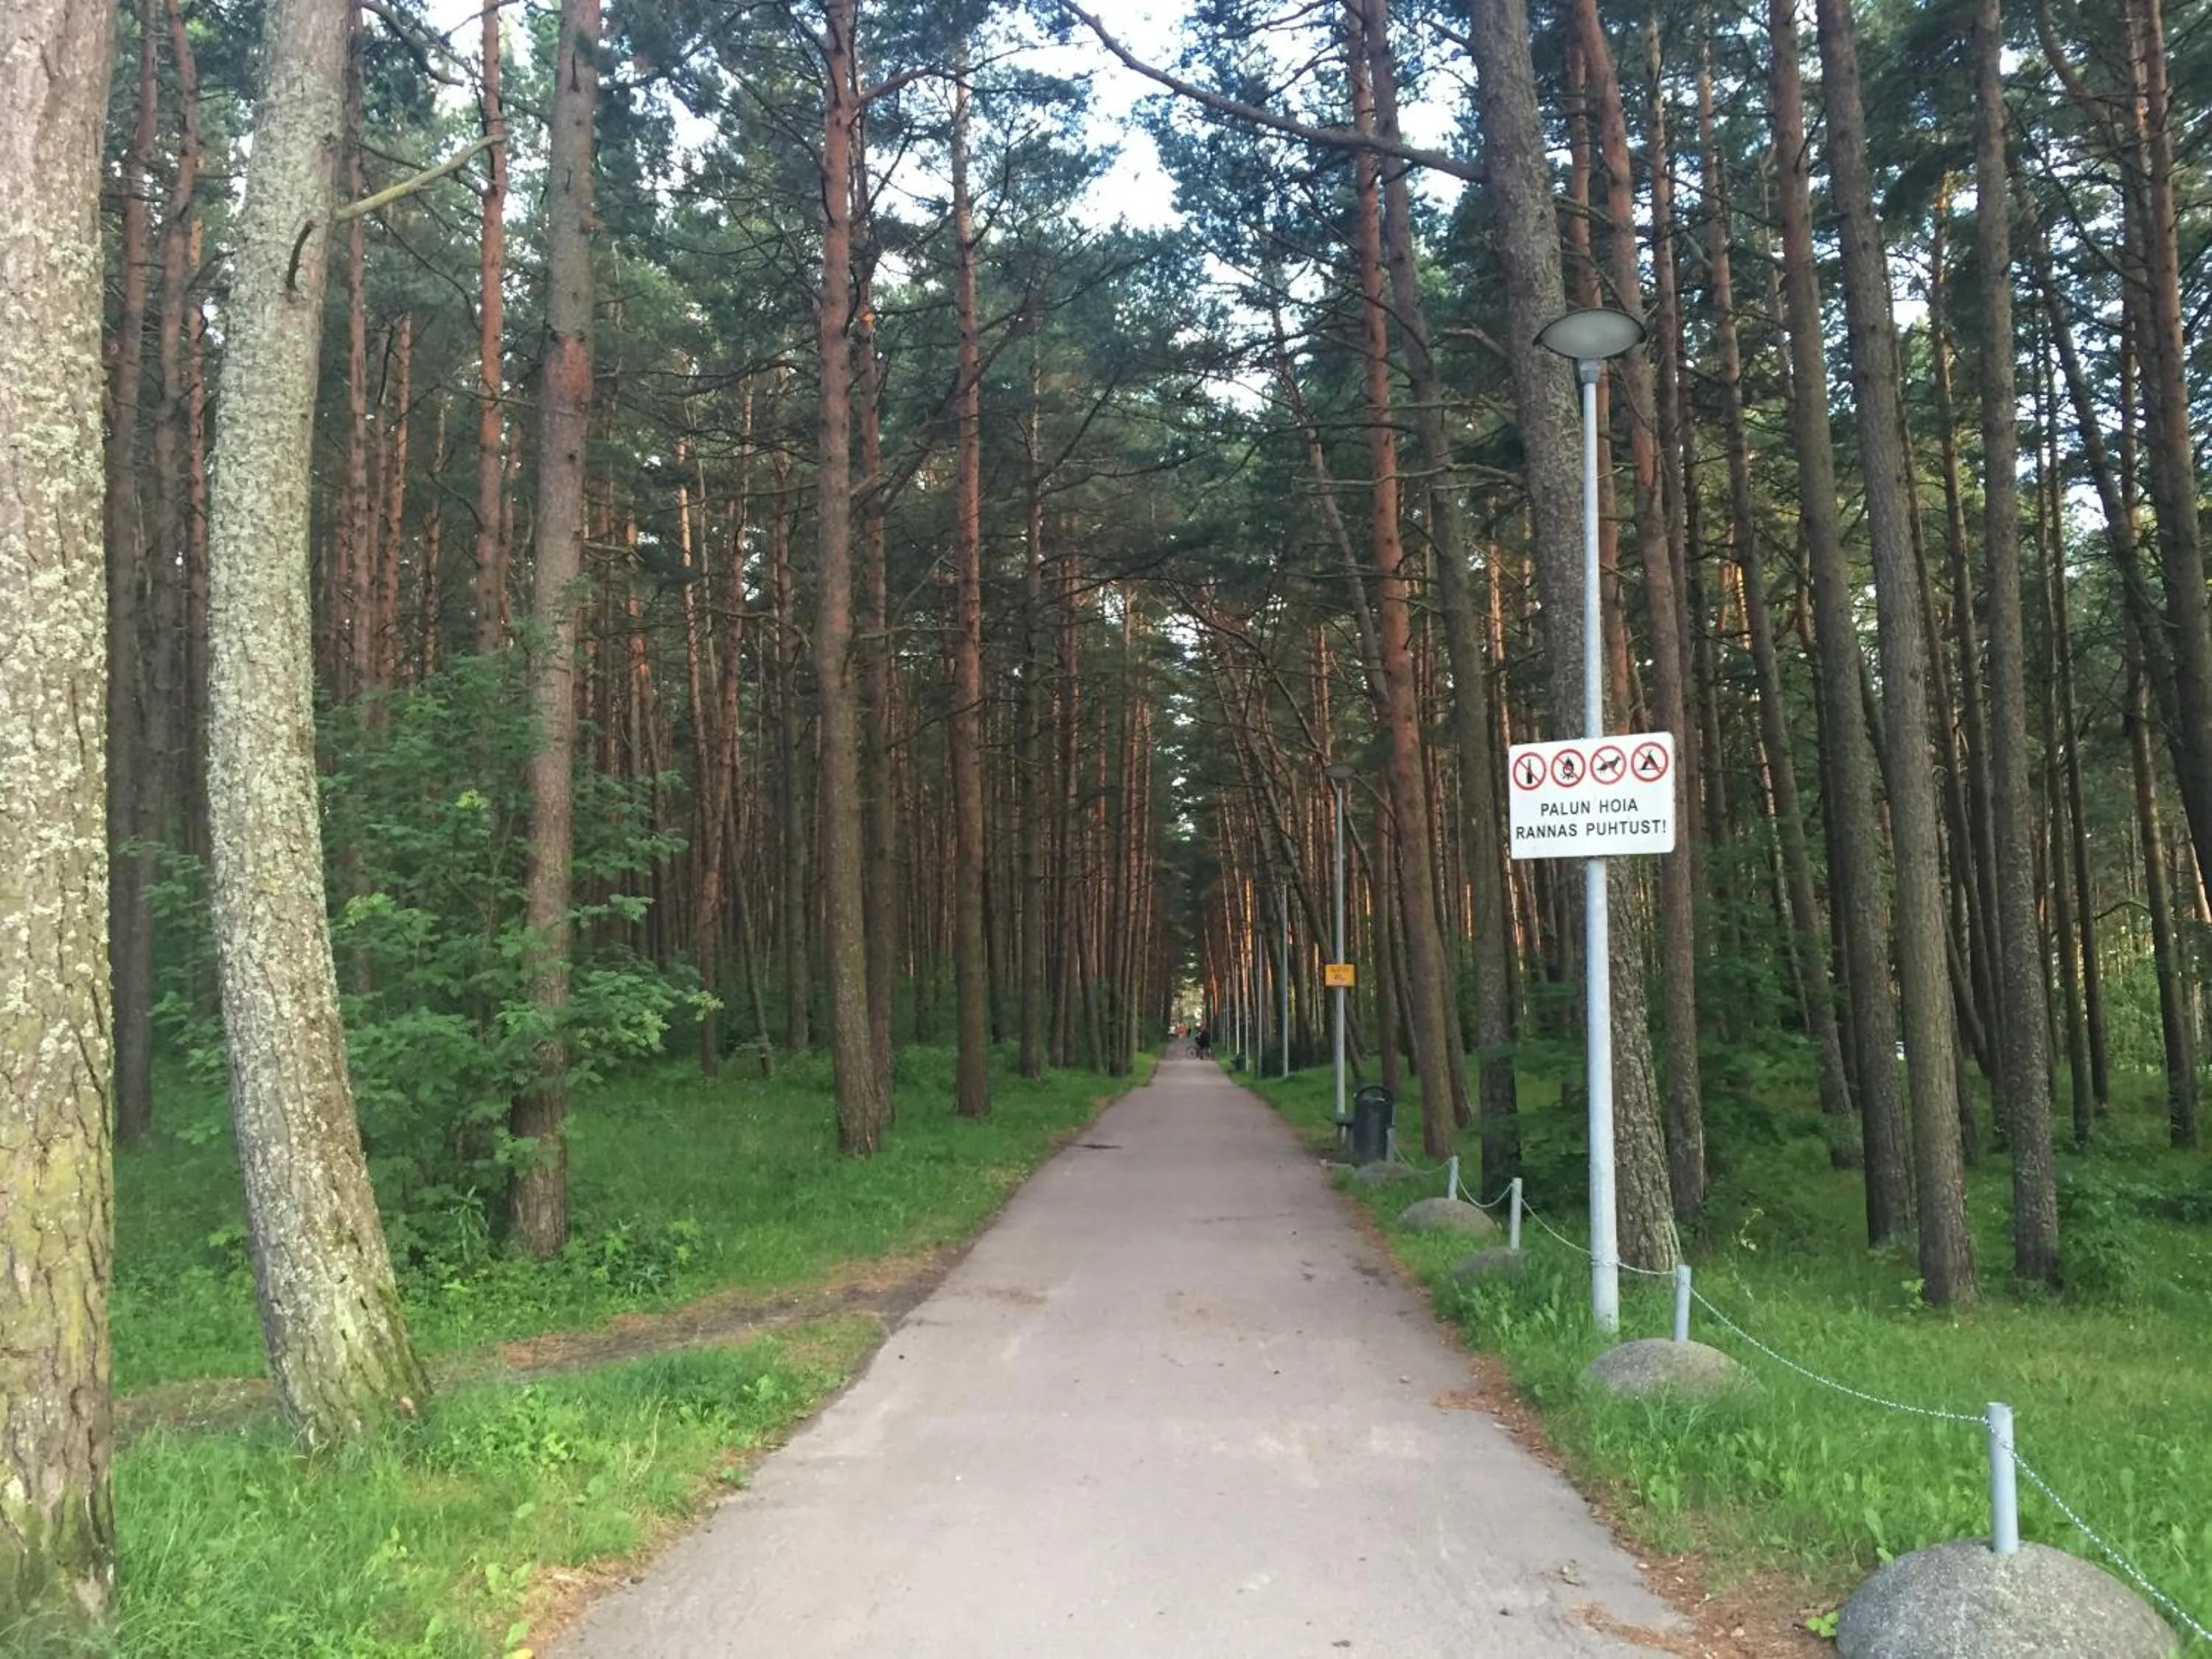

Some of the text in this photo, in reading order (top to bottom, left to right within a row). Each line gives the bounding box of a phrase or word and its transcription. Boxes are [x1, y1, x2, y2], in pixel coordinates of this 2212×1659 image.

[1540, 798, 1638, 816] PALUN HOIA
[1516, 819, 1666, 839] RANNAS PUHTUST!
